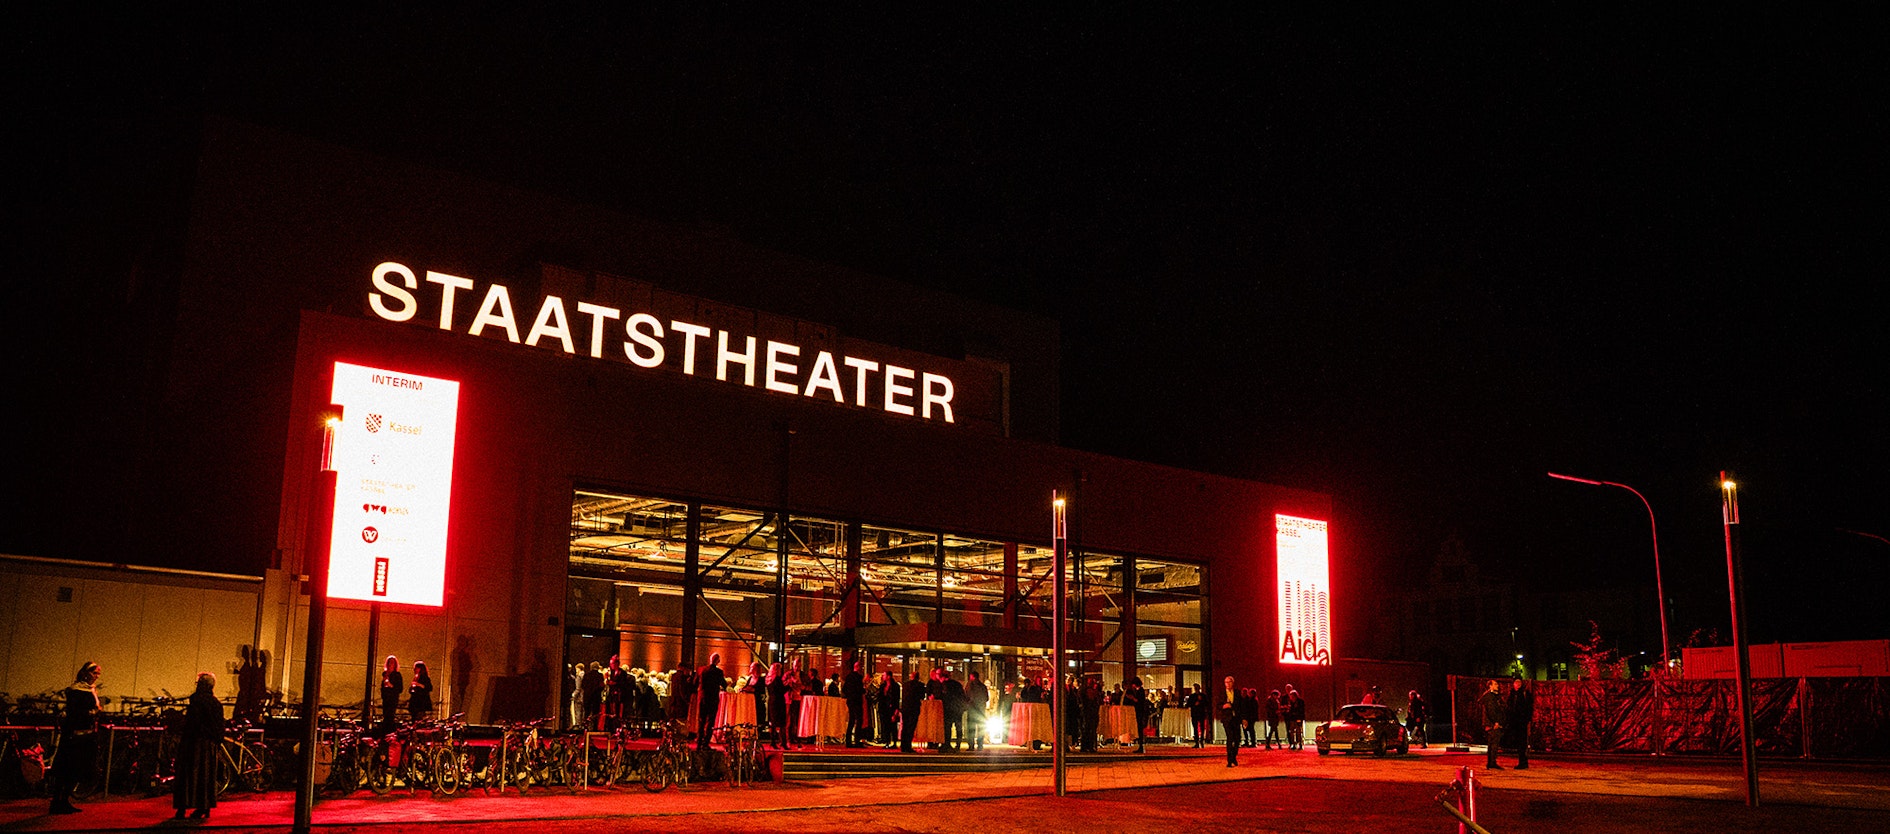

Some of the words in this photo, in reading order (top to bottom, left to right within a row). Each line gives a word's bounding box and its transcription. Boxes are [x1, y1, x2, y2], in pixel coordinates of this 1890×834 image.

[368, 261, 955, 424] STAATSTHEATER
[371, 373, 423, 391] INTERIM
[388, 420, 423, 436] Kassel
[1281, 629, 1330, 666] Aida
